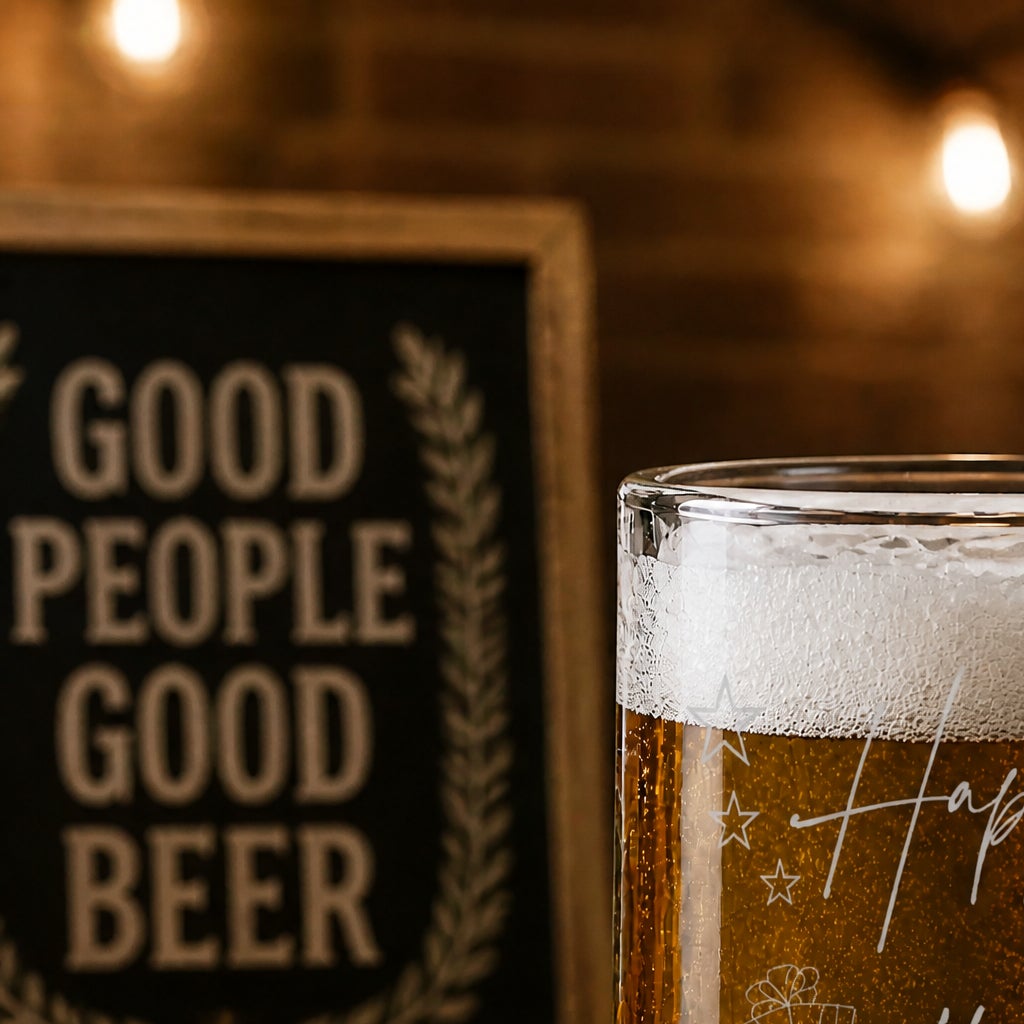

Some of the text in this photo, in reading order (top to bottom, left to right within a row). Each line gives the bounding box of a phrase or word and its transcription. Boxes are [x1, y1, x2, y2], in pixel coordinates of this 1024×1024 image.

[50, 358, 365, 500] GOOD
[9, 516, 416, 646] PEOPLE
[54, 662, 374, 806] GOOD
[61, 822, 382, 974] BEER
